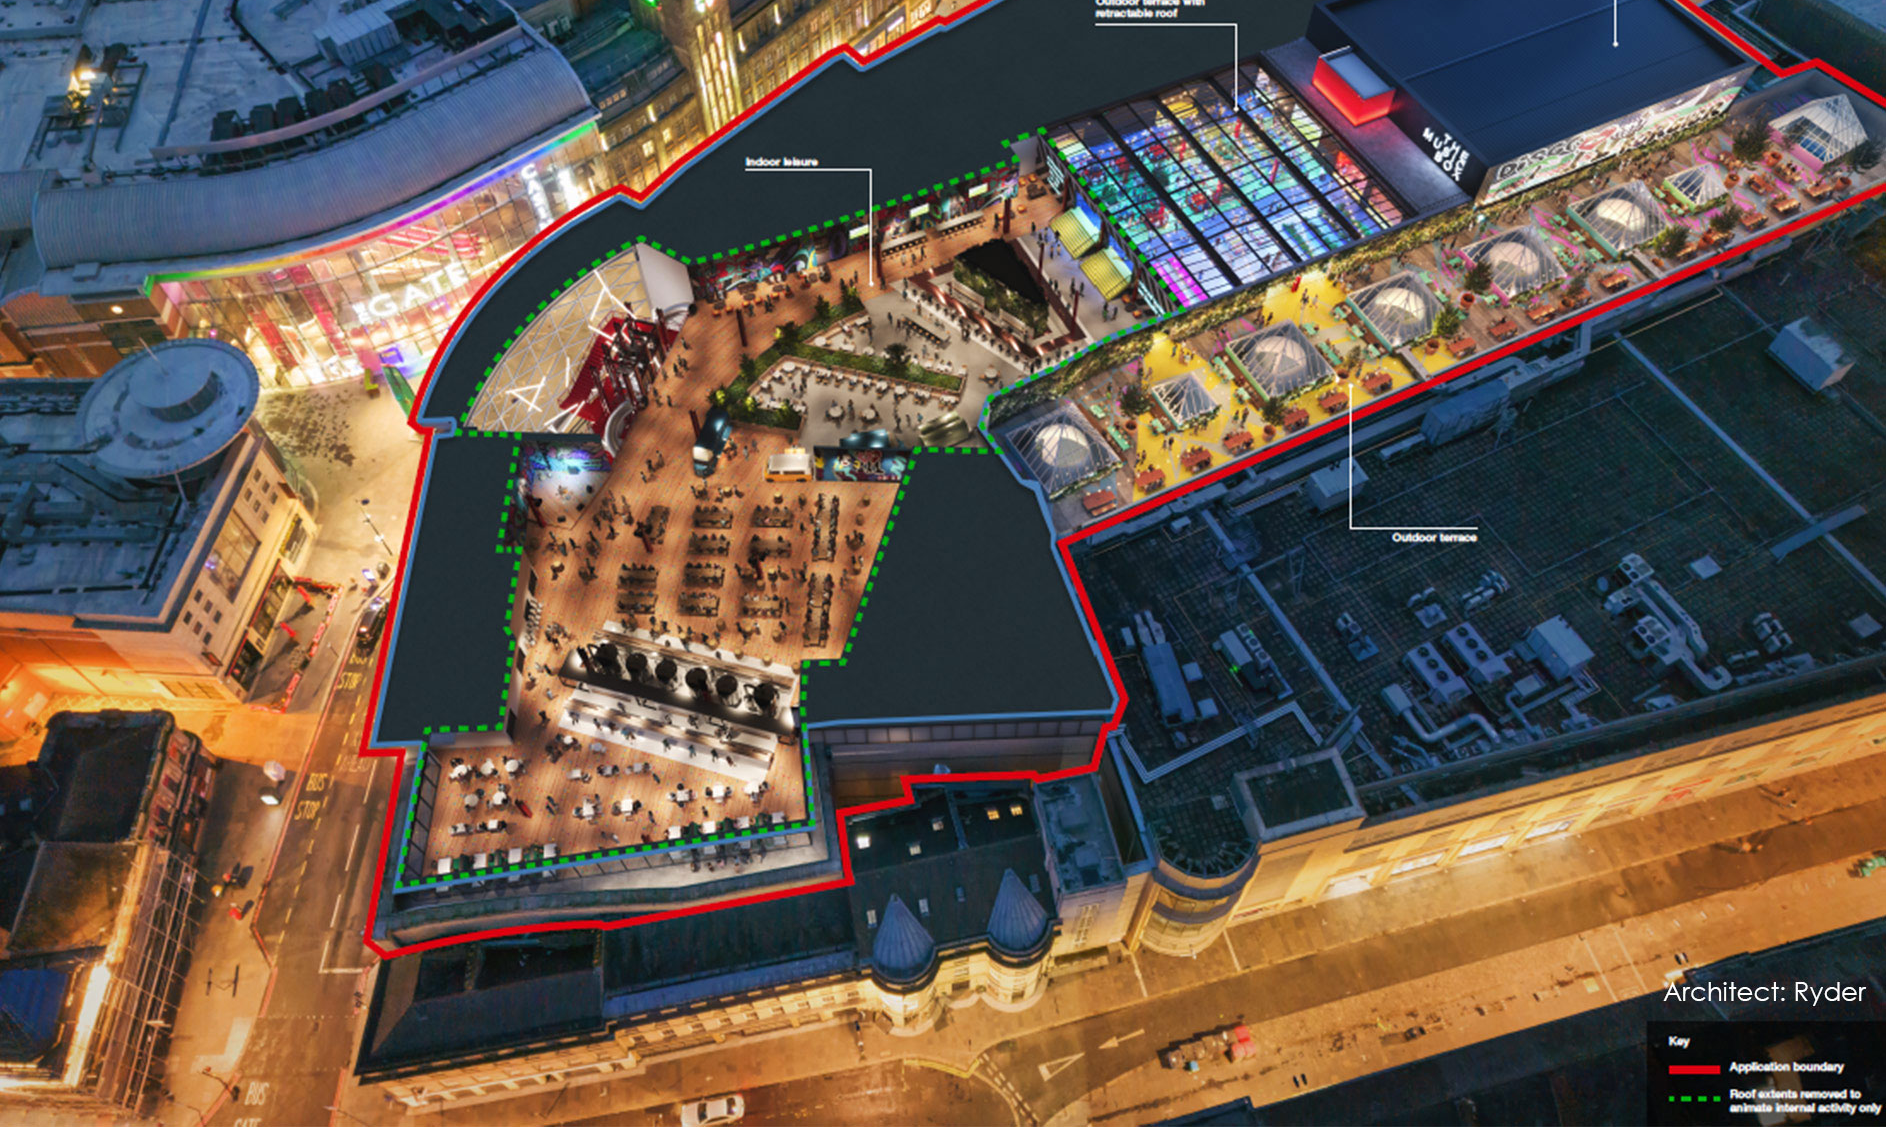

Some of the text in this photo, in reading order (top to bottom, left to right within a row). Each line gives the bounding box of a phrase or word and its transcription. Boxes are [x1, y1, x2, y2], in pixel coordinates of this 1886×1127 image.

[1434, 150, 1462, 182] BOX
[367, 262, 470, 317] GATE
[336, 672, 363, 690] STOP
[306, 772, 329, 791] BUS
[294, 800, 321, 821] STOP
[244, 1080, 270, 1106] BUS
